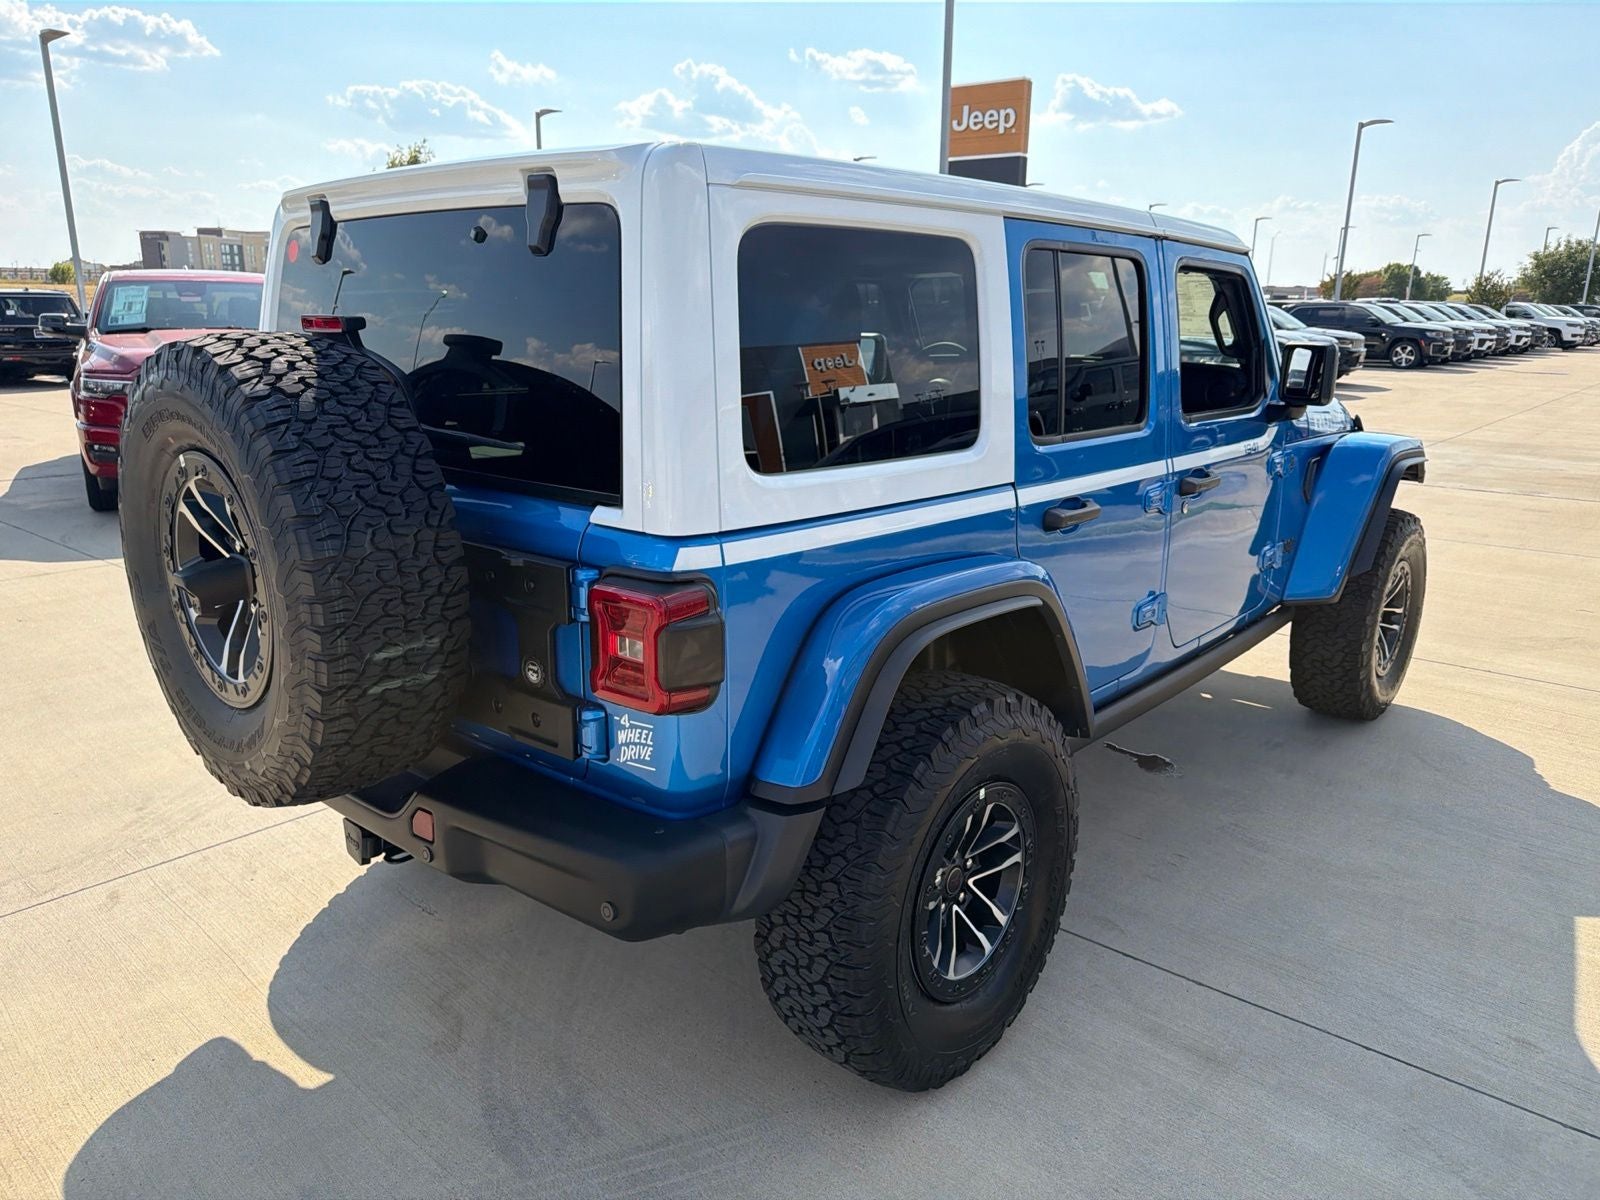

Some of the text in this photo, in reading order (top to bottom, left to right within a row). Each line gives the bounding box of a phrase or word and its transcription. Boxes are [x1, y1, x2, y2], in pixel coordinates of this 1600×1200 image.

[952, 104, 1016, 134] Jeep
[620, 713, 630, 728] 4
[617, 728, 653, 745] WHEEL
[620, 744, 653, 763] DRIVE
